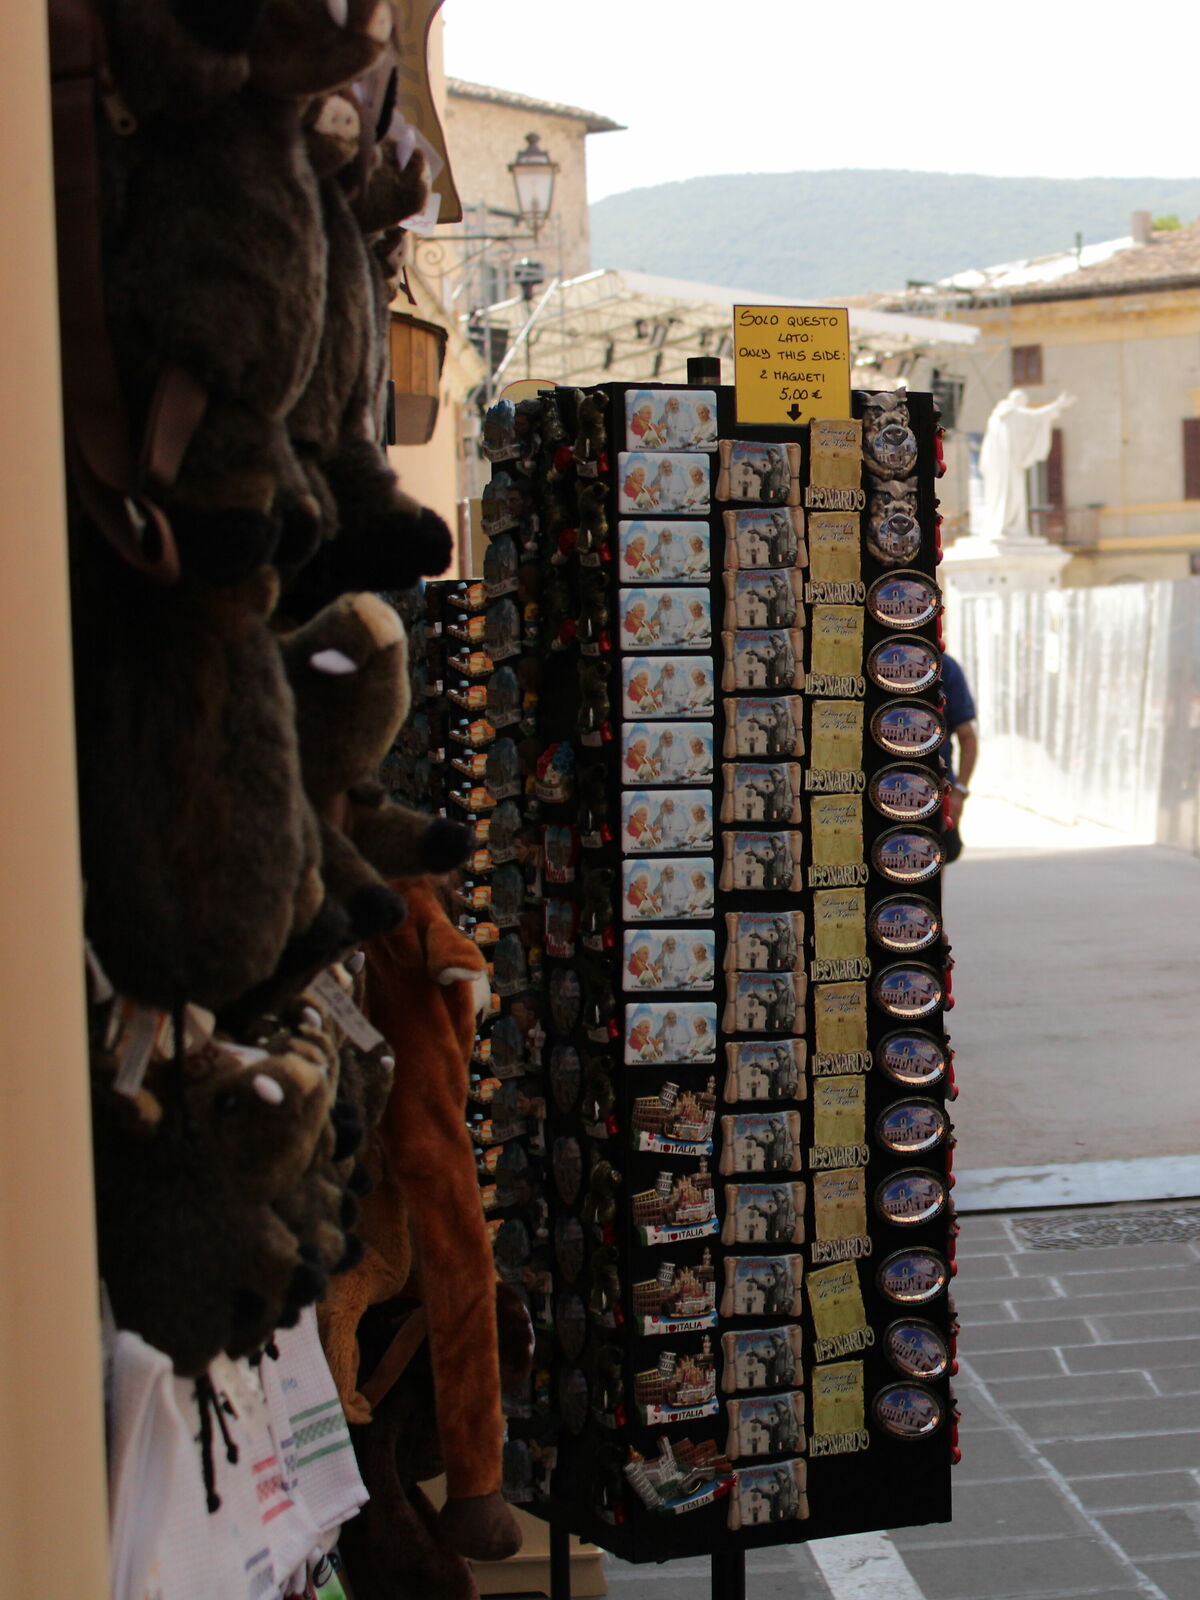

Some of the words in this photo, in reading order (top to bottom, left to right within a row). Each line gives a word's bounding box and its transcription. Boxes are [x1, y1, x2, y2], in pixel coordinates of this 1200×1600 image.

[787, 316, 838, 327] QUESTO
[778, 333, 814, 342] LATO:
[777, 351, 806, 361] THIS
[811, 351, 846, 361] SIDE:
[760, 369, 768, 379] 2
[774, 371, 825, 382] MAGNETI
[779, 387, 808, 400] 5,00
[811, 389, 822, 399] €
[805, 487, 865, 510] LEONARDO
[805, 581, 866, 605] LEONARDO
[805, 673, 866, 697] LEONARDO
[805, 769, 866, 793] LEONARDO
[808, 865, 869, 887] LEONARDO
[810, 959, 871, 982] LEONARDO
[813, 1052, 873, 1076] LEONARDO
[671, 1144, 696, 1155] ITALIA
[809, 1144, 870, 1169] LEONARDO
[678, 1227, 704, 1239] ITALIA
[811, 1237, 872, 1264] LEONARDO
[677, 1321, 703, 1332] ITALIA
[814, 1326, 875, 1363] LEONARDO
[677, 1409, 703, 1421] ITALIA
[809, 1430, 870, 1457] LEONARDO
[682, 1496, 712, 1512] ITALIA
